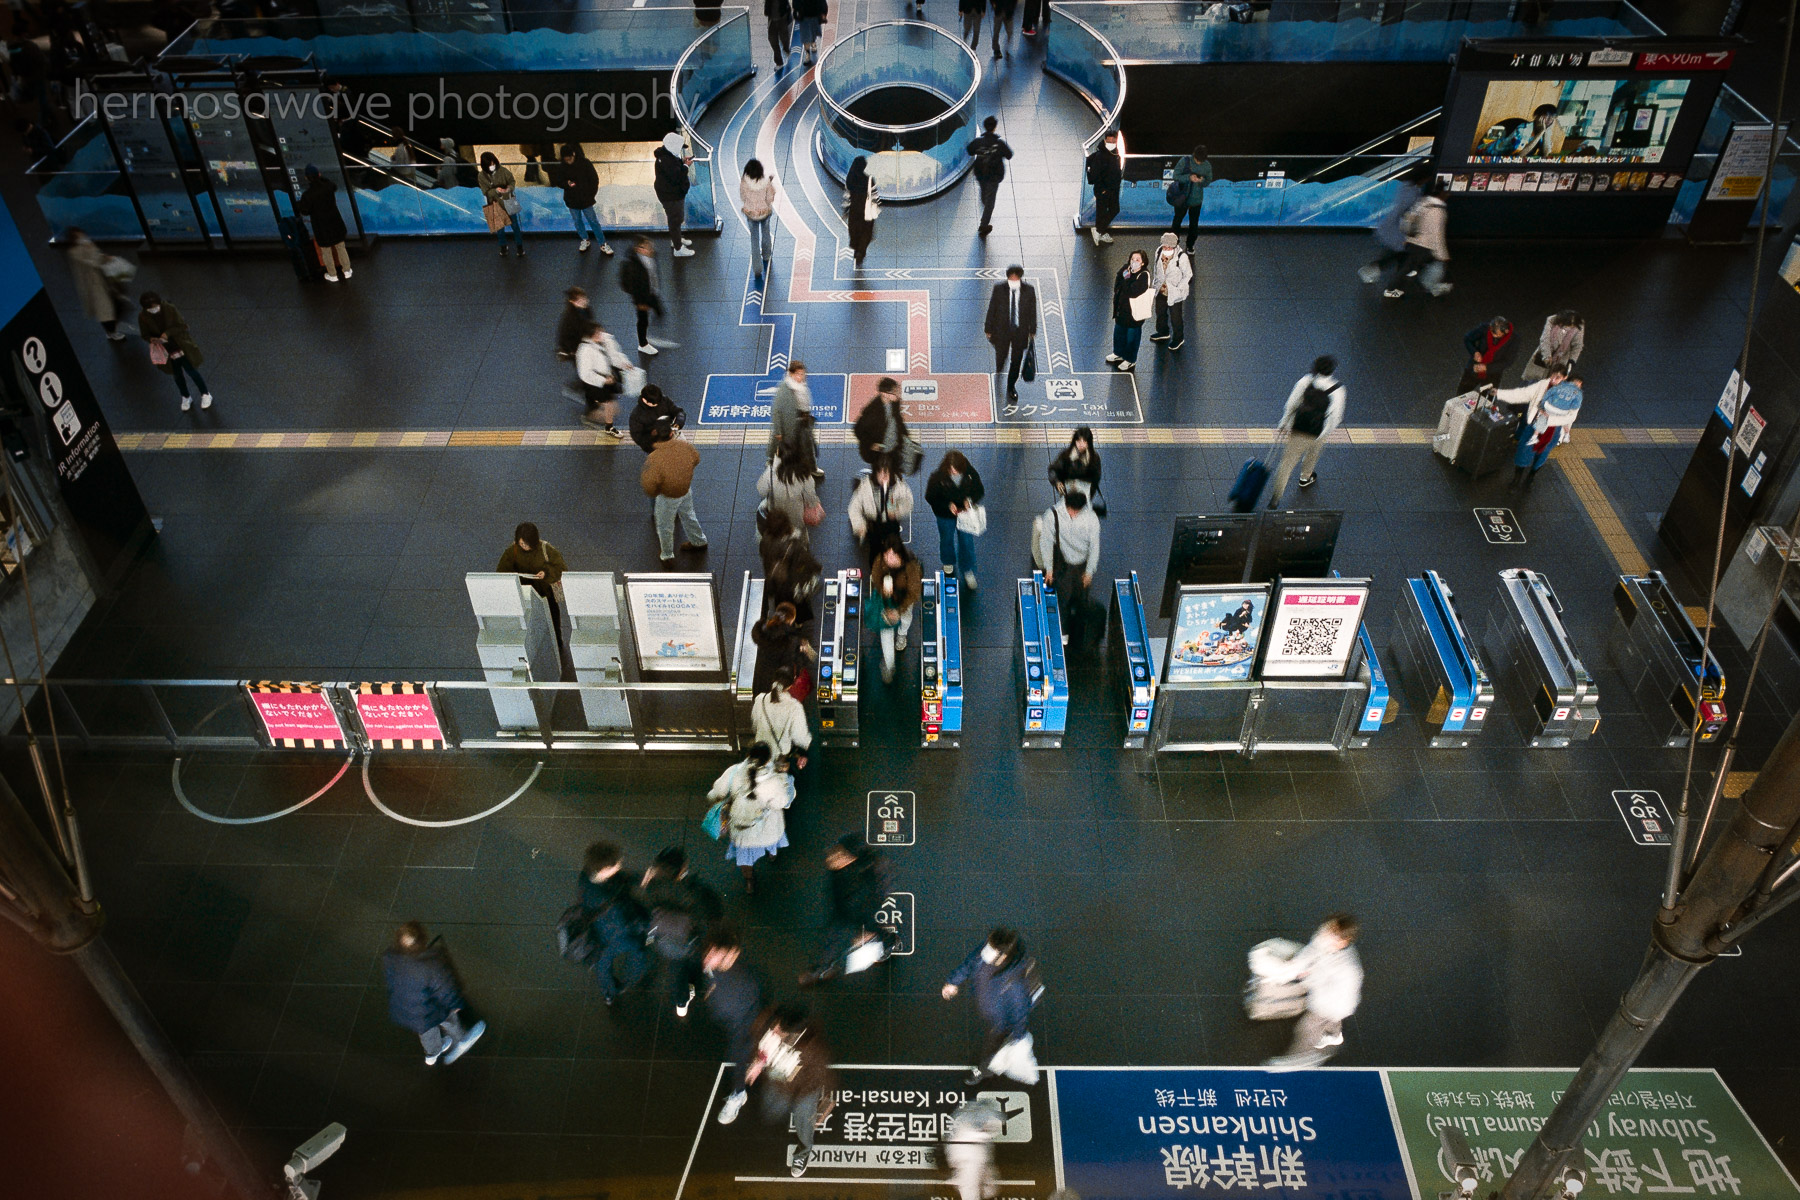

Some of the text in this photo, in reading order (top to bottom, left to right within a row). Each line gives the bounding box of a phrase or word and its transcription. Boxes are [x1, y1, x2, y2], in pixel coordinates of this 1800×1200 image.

[708, 404, 772, 418] 新幹線
[918, 403, 941, 411] Bus
[1002, 403, 1078, 417] タクシー
[1081, 403, 1108, 411] Taxi
[58, 461, 67, 476] JR
[66, 421, 100, 465] Information
[1488, 524, 1513, 533] QR
[265, 710, 322, 718] ないでください
[1031, 709, 1043, 718] IC
[877, 806, 905, 819] QR
[1630, 805, 1661, 819] QR
[874, 910, 904, 924] QR
[935, 1090, 968, 1108] for
[1154, 1087, 1218, 1108] 新干线
[1233, 1088, 1288, 1108] 신칸센
[1138, 1115, 1318, 1143] Shinkansen
[1608, 1111, 1717, 1145] Subway
[809, 1149, 867, 1163] HARUK
[1159, 1144, 1308, 1191] 新幹線
